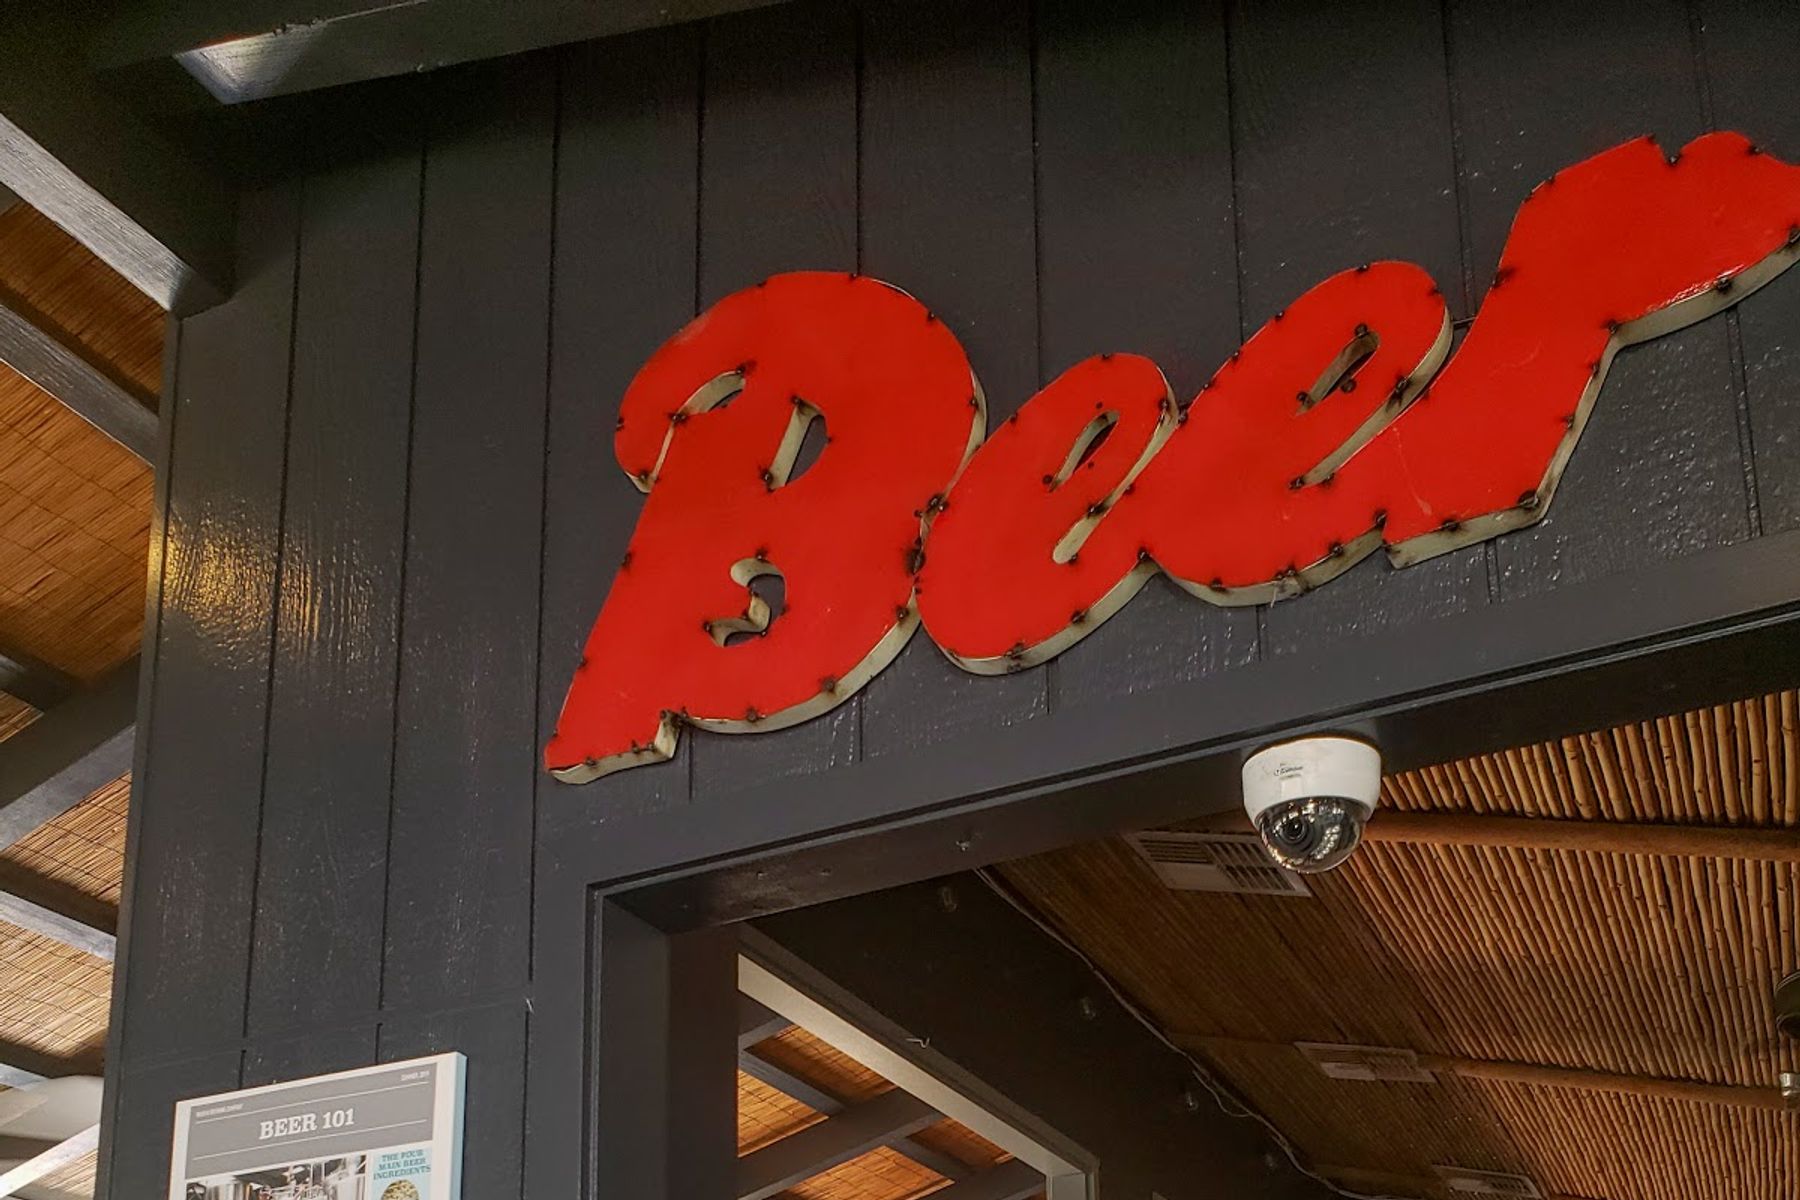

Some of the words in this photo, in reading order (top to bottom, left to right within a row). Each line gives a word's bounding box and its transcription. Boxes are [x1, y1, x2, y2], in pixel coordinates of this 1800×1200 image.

[544, 130, 1800, 783] Beer
[259, 1113, 318, 1140] BEER
[322, 1108, 354, 1130] 101
[373, 1165, 431, 1180] INGREDIENTS
